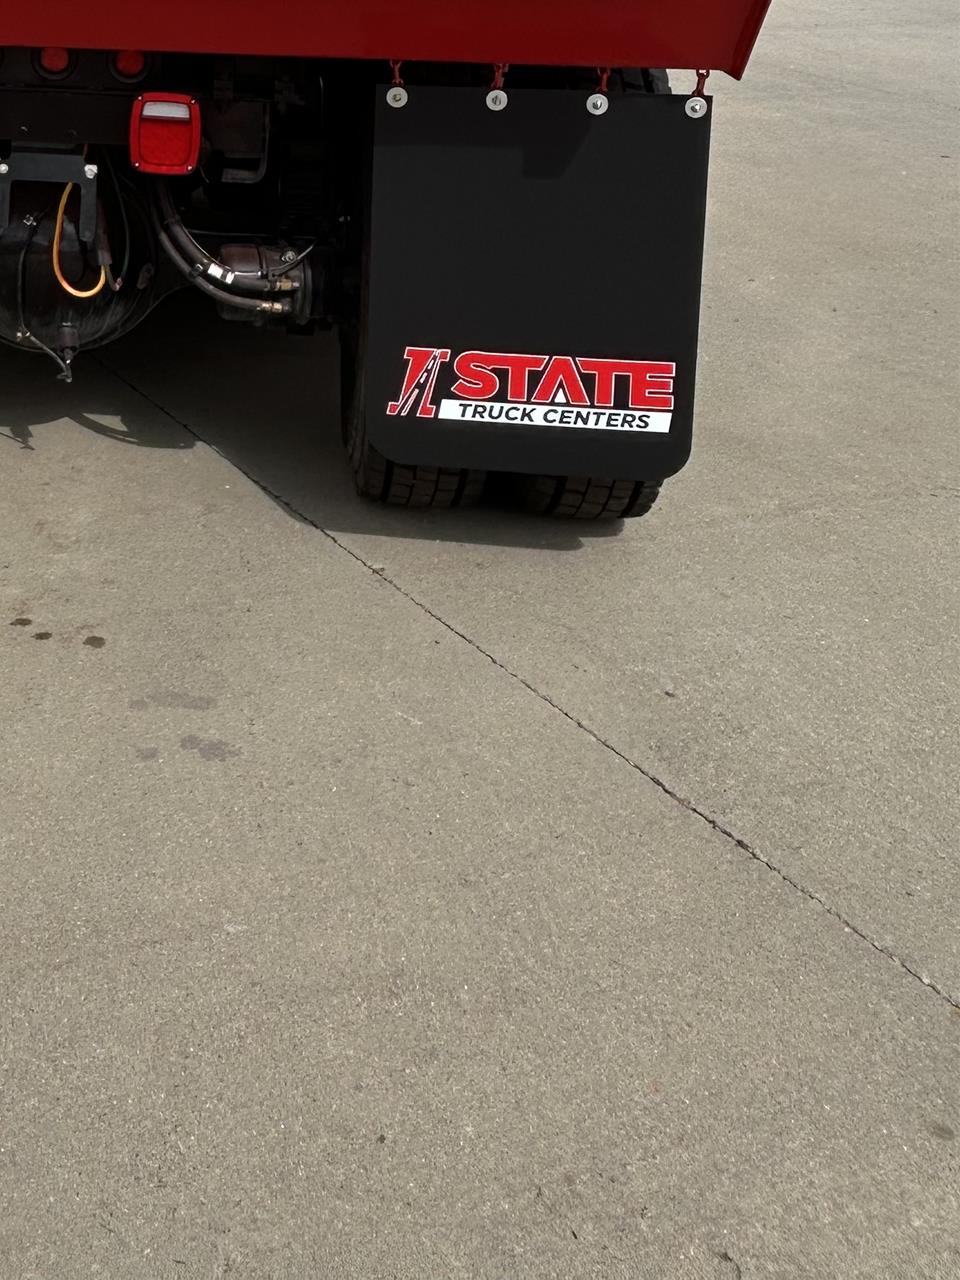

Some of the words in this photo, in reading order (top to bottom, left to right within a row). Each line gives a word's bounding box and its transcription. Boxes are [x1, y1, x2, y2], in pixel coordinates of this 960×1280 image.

[451, 351, 676, 409] STATE
[458, 403, 536, 423] TRUCK
[542, 408, 651, 429] CENTERS
